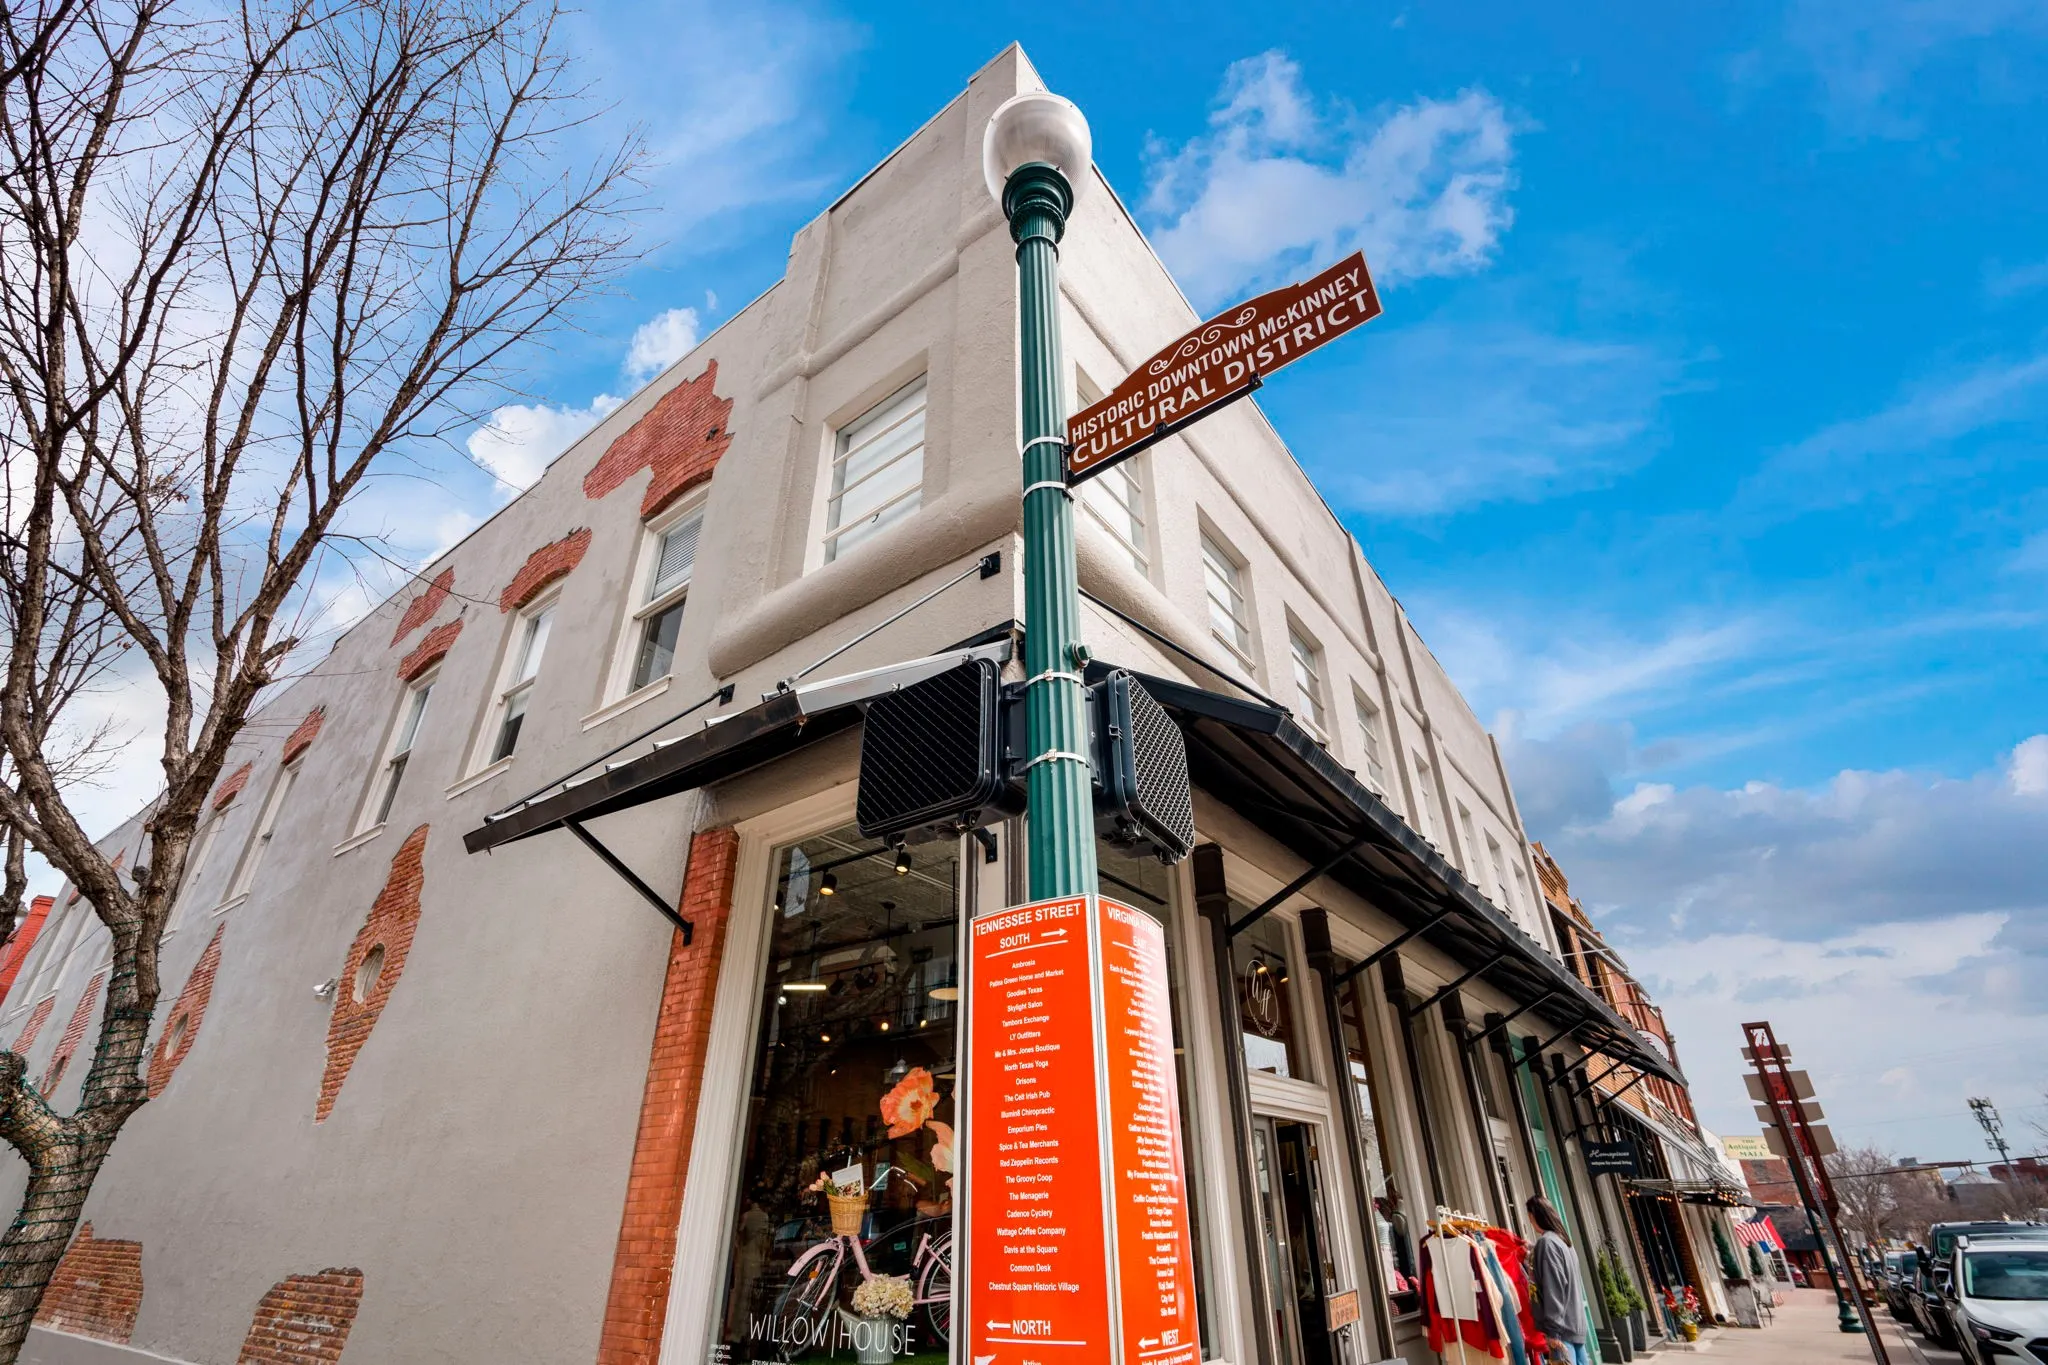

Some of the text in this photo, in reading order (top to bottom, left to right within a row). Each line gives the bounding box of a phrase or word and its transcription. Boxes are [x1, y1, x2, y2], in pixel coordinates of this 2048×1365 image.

[1072, 268, 1359, 443] HISTORIC DOWNTOWN McKINNEY
[1073, 288, 1369, 464] CULTURAL DISTRICT
[976, 903, 1080, 936] TENNESSEE STREET
[1107, 906, 1139, 926] VIRGINIA
[1000, 933, 1030, 949] SOUTH
[1012, 959, 1035, 969] Ambrosia
[1004, 976, 1018, 985] Green
[1019, 974, 1033, 982] Home
[1045, 969, 1064, 978] Market
[1007, 986, 1042, 998] Goodies Texas
[1007, 1000, 1042, 1013] Skylight Salon
[1024, 1015, 1050, 1025] Exchange
[1019, 1046, 1034, 1055] Jones
[1035, 1043, 1060, 1053] Boutique
[1004, 1060, 1048, 1072] North Texas Yoga
[1004, 1095, 1013, 1103] The
[1026, 1092, 1038, 1100] Irish
[1039, 1091, 1050, 1099] Pub
[1021, 1107, 1055, 1117] Chiropractic
[1008, 1125, 1034, 1135] Emporium
[999, 1142, 1013, 1152] Spice
[1019, 1141, 1029, 1149] Tea
[1029, 1139, 1058, 1148] Merchants
[1000, 1156, 1058, 1168] Red Zeppelin Records
[1006, 1174, 1052, 1183] The Groovy Coop
[1009, 1192, 1049, 1200] The Menagerie
[1006, 1209, 1052, 1218] Cadence Cyclery
[997, 1226, 1065, 1237] Wattage Coffee Company
[1004, 1245, 1018, 1254] Davis
[1026, 1245, 1035, 1253] the
[1036, 1245, 1057, 1254] Square
[1010, 1263, 1051, 1272] Common Desk
[989, 1282, 1079, 1293] Chestnut Square Historic Village
[1013, 1320, 1051, 1336] NORTH
[750, 1313, 916, 1356] WILLOW HOUSE
[1161, 1329, 1179, 1346] WEST
